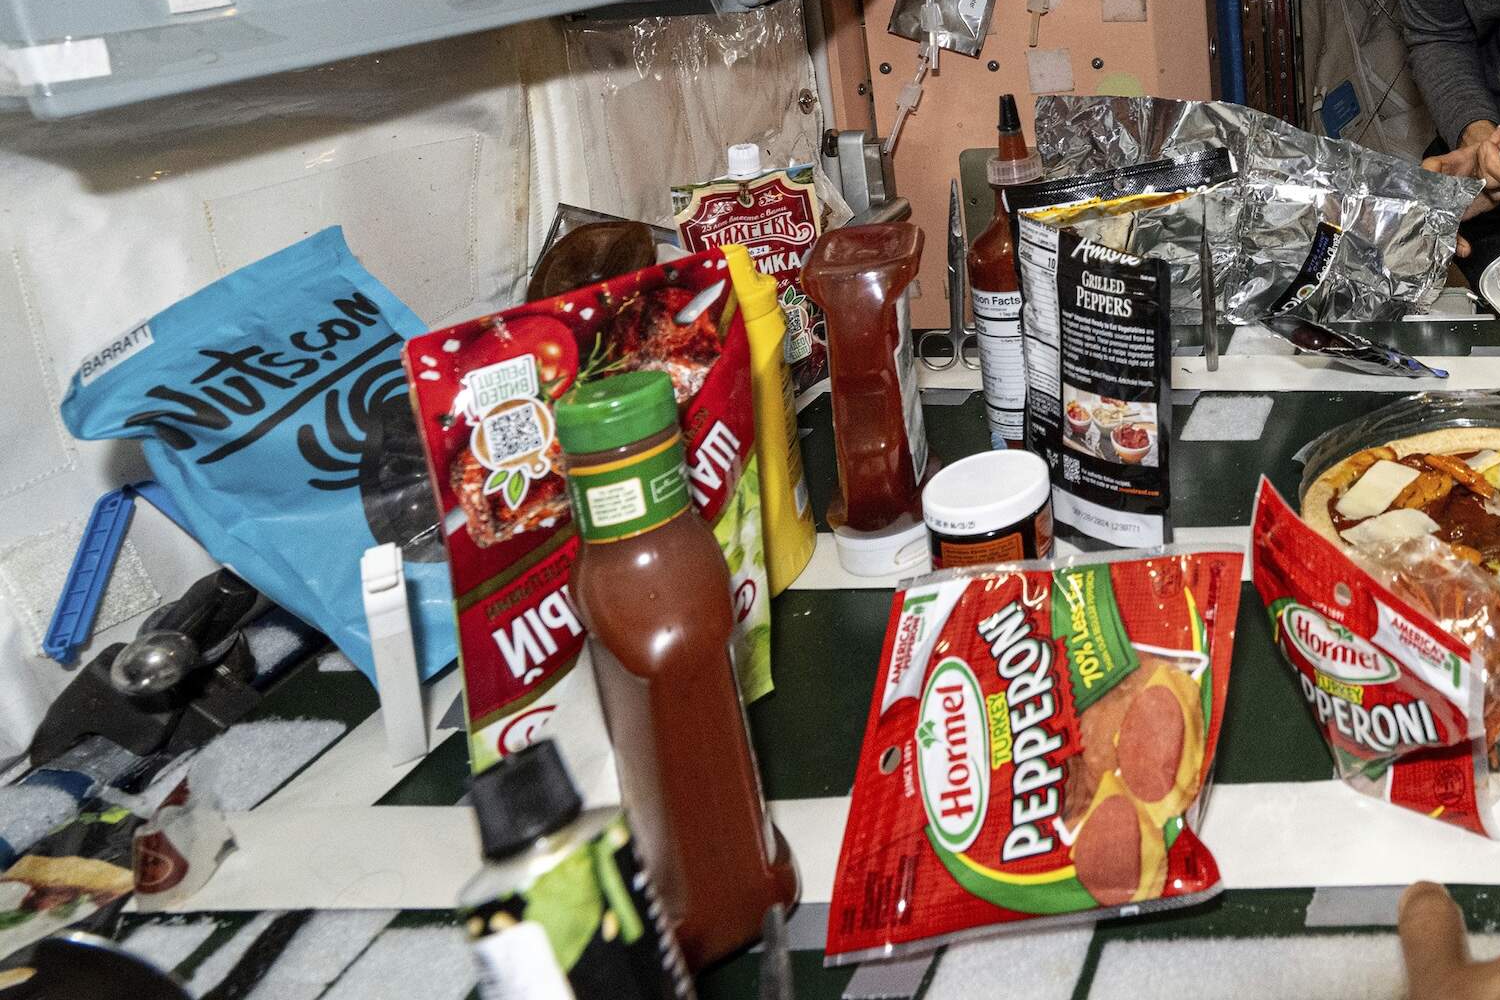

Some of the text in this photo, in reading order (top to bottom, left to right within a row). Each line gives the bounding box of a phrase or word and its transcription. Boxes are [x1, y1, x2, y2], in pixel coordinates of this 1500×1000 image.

[701, 224, 712, 233] 25
[991, 295, 1021, 306] Facts
[1075, 285, 1133, 318] PEPPERS
[1082, 270, 1125, 295] GRILLED
[81, 323, 150, 379] BARRATT
[476, 363, 527, 390] РЕЦЕПТ
[478, 378, 530, 405] ВИДЕО
[890, 614, 914, 684] AMERICA'S
[1070, 601, 1103, 689] 70% Less
[1296, 615, 1380, 672] Hormel
[1390, 616, 1446, 659] AMERICA'S
[941, 684, 974, 820] Hormel
[977, 602, 1063, 862] PEPPERONI
[988, 692, 1011, 764] TURKEY
